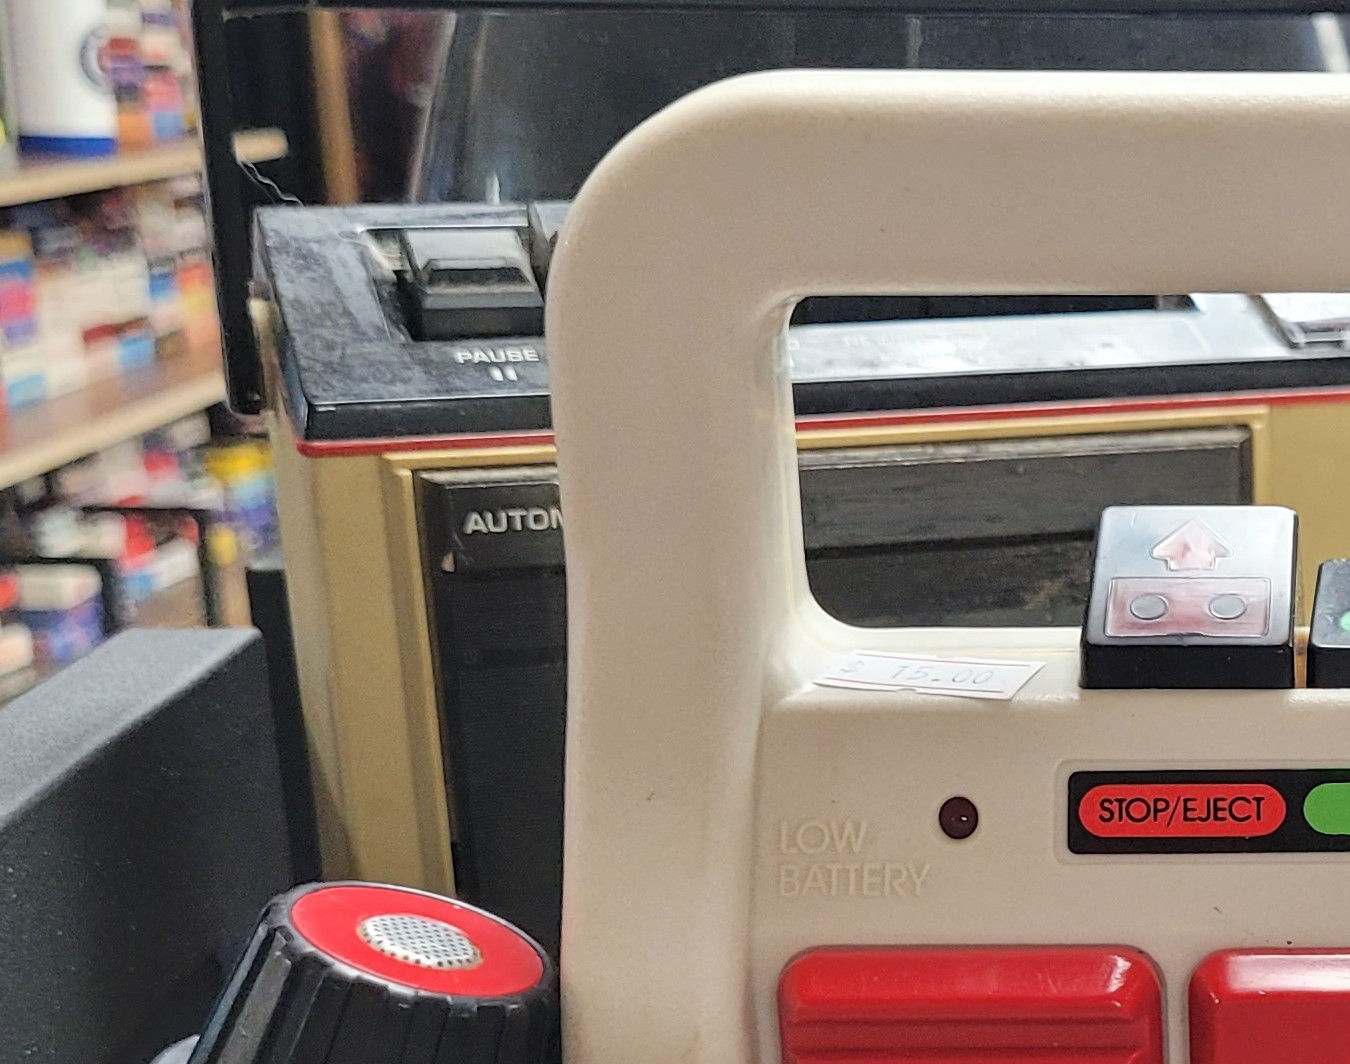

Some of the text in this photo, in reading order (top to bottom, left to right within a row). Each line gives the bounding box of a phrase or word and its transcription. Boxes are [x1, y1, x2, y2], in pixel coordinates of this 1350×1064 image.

[453, 347, 540, 364] PAUSE
[1097, 795, 1266, 828] STOP/EJECT
[780, 821, 867, 853] LOW
[780, 864, 930, 897] BATTERY
